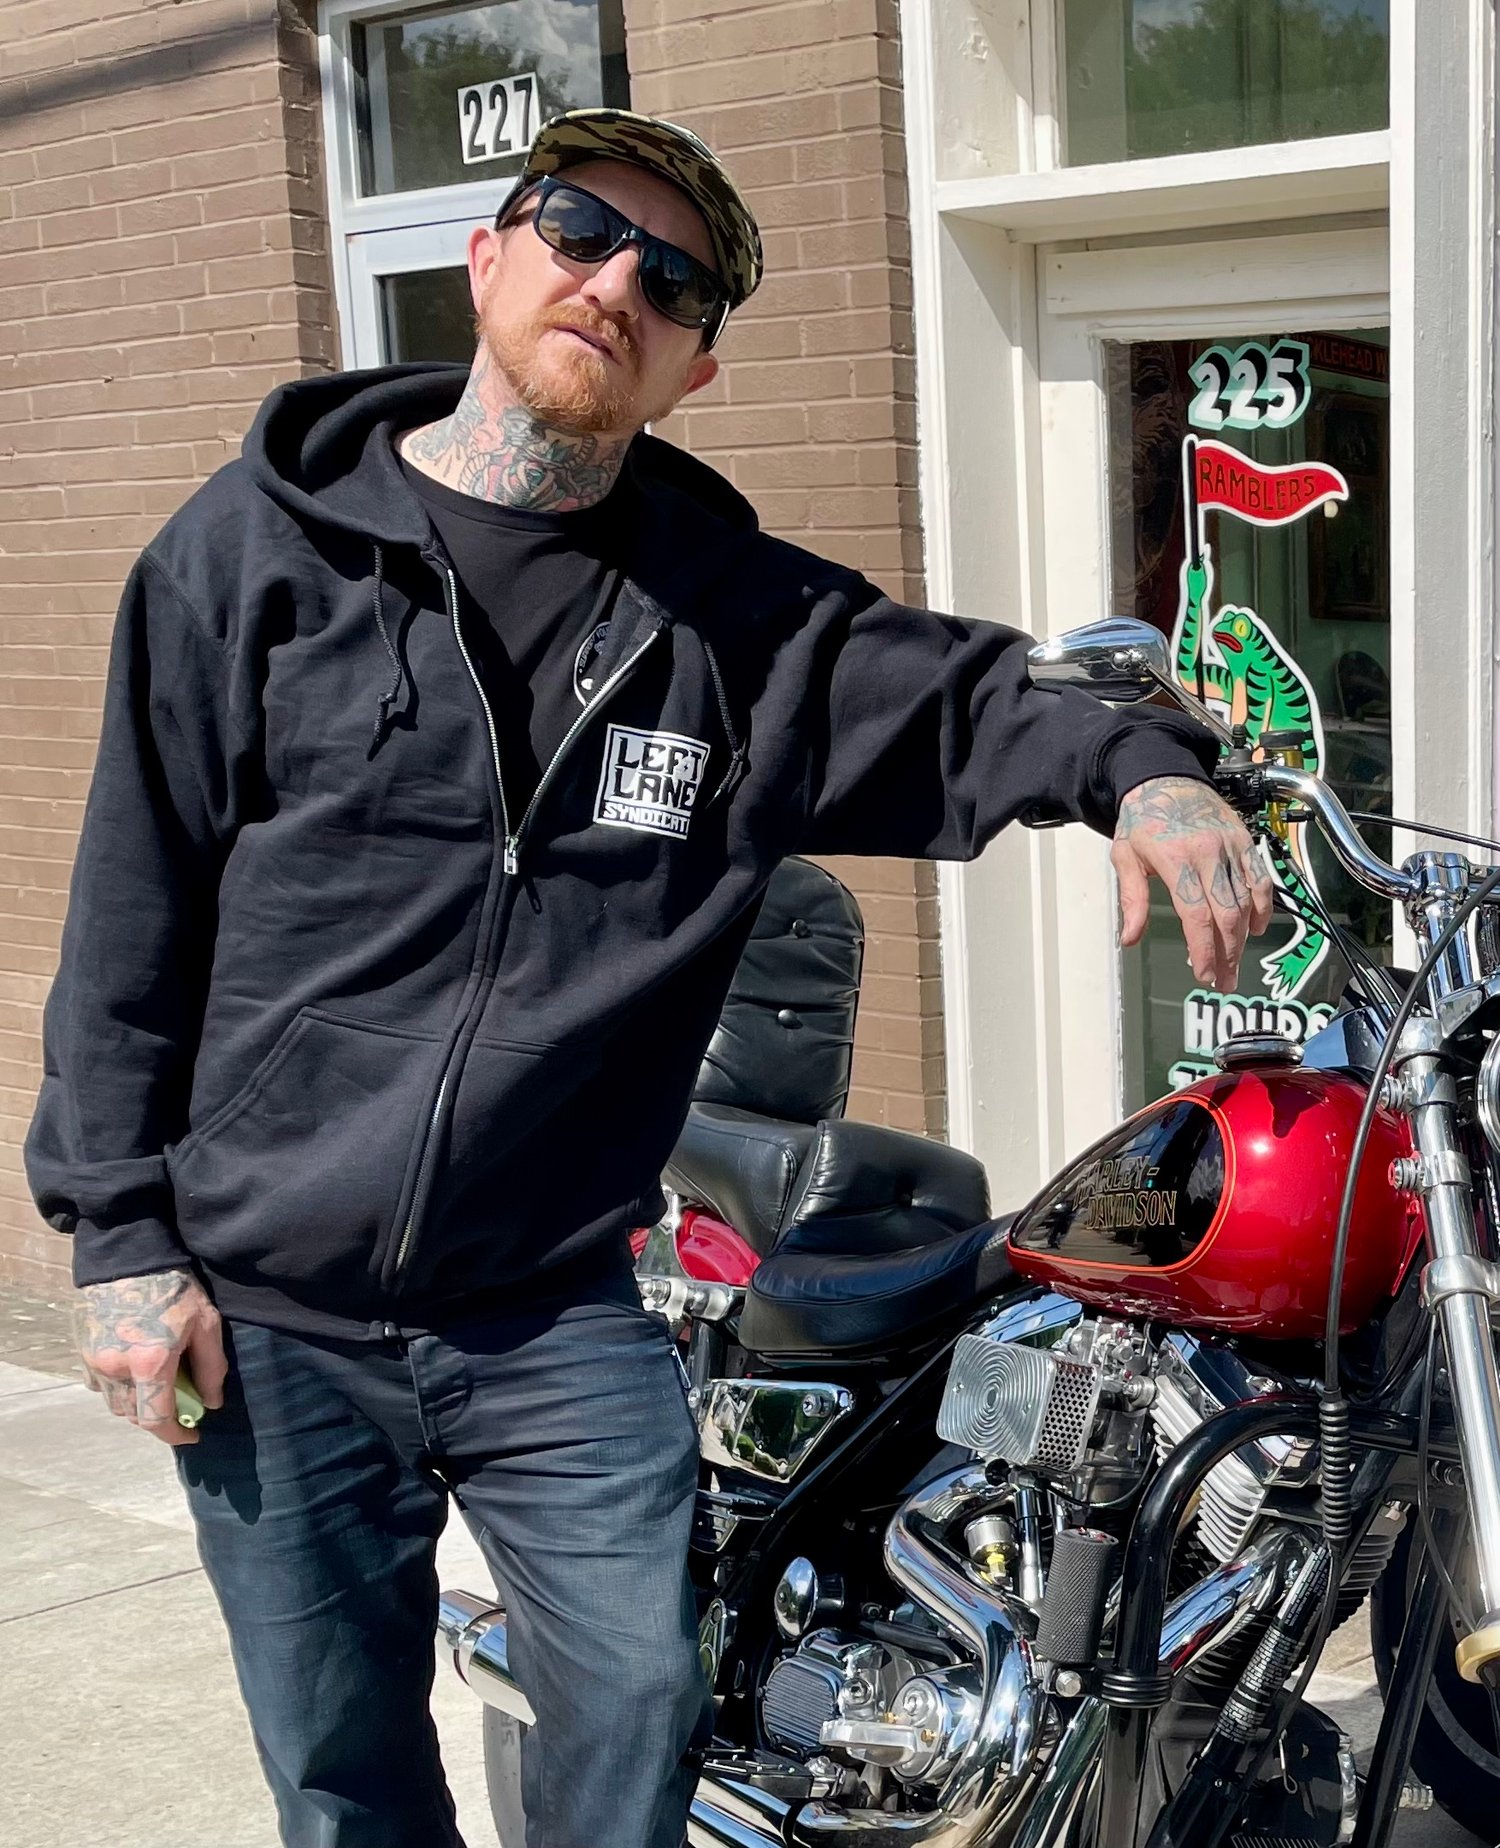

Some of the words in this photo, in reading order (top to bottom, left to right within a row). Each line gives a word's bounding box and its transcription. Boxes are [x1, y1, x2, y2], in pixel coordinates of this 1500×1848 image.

[464, 77, 532, 158] 227
[1193, 346, 1306, 424] 225
[1199, 457, 1315, 511] RAMBLERS
[602, 801, 691, 834] SYNDICAT
[1086, 1190, 1178, 1230] DAVIDSON
